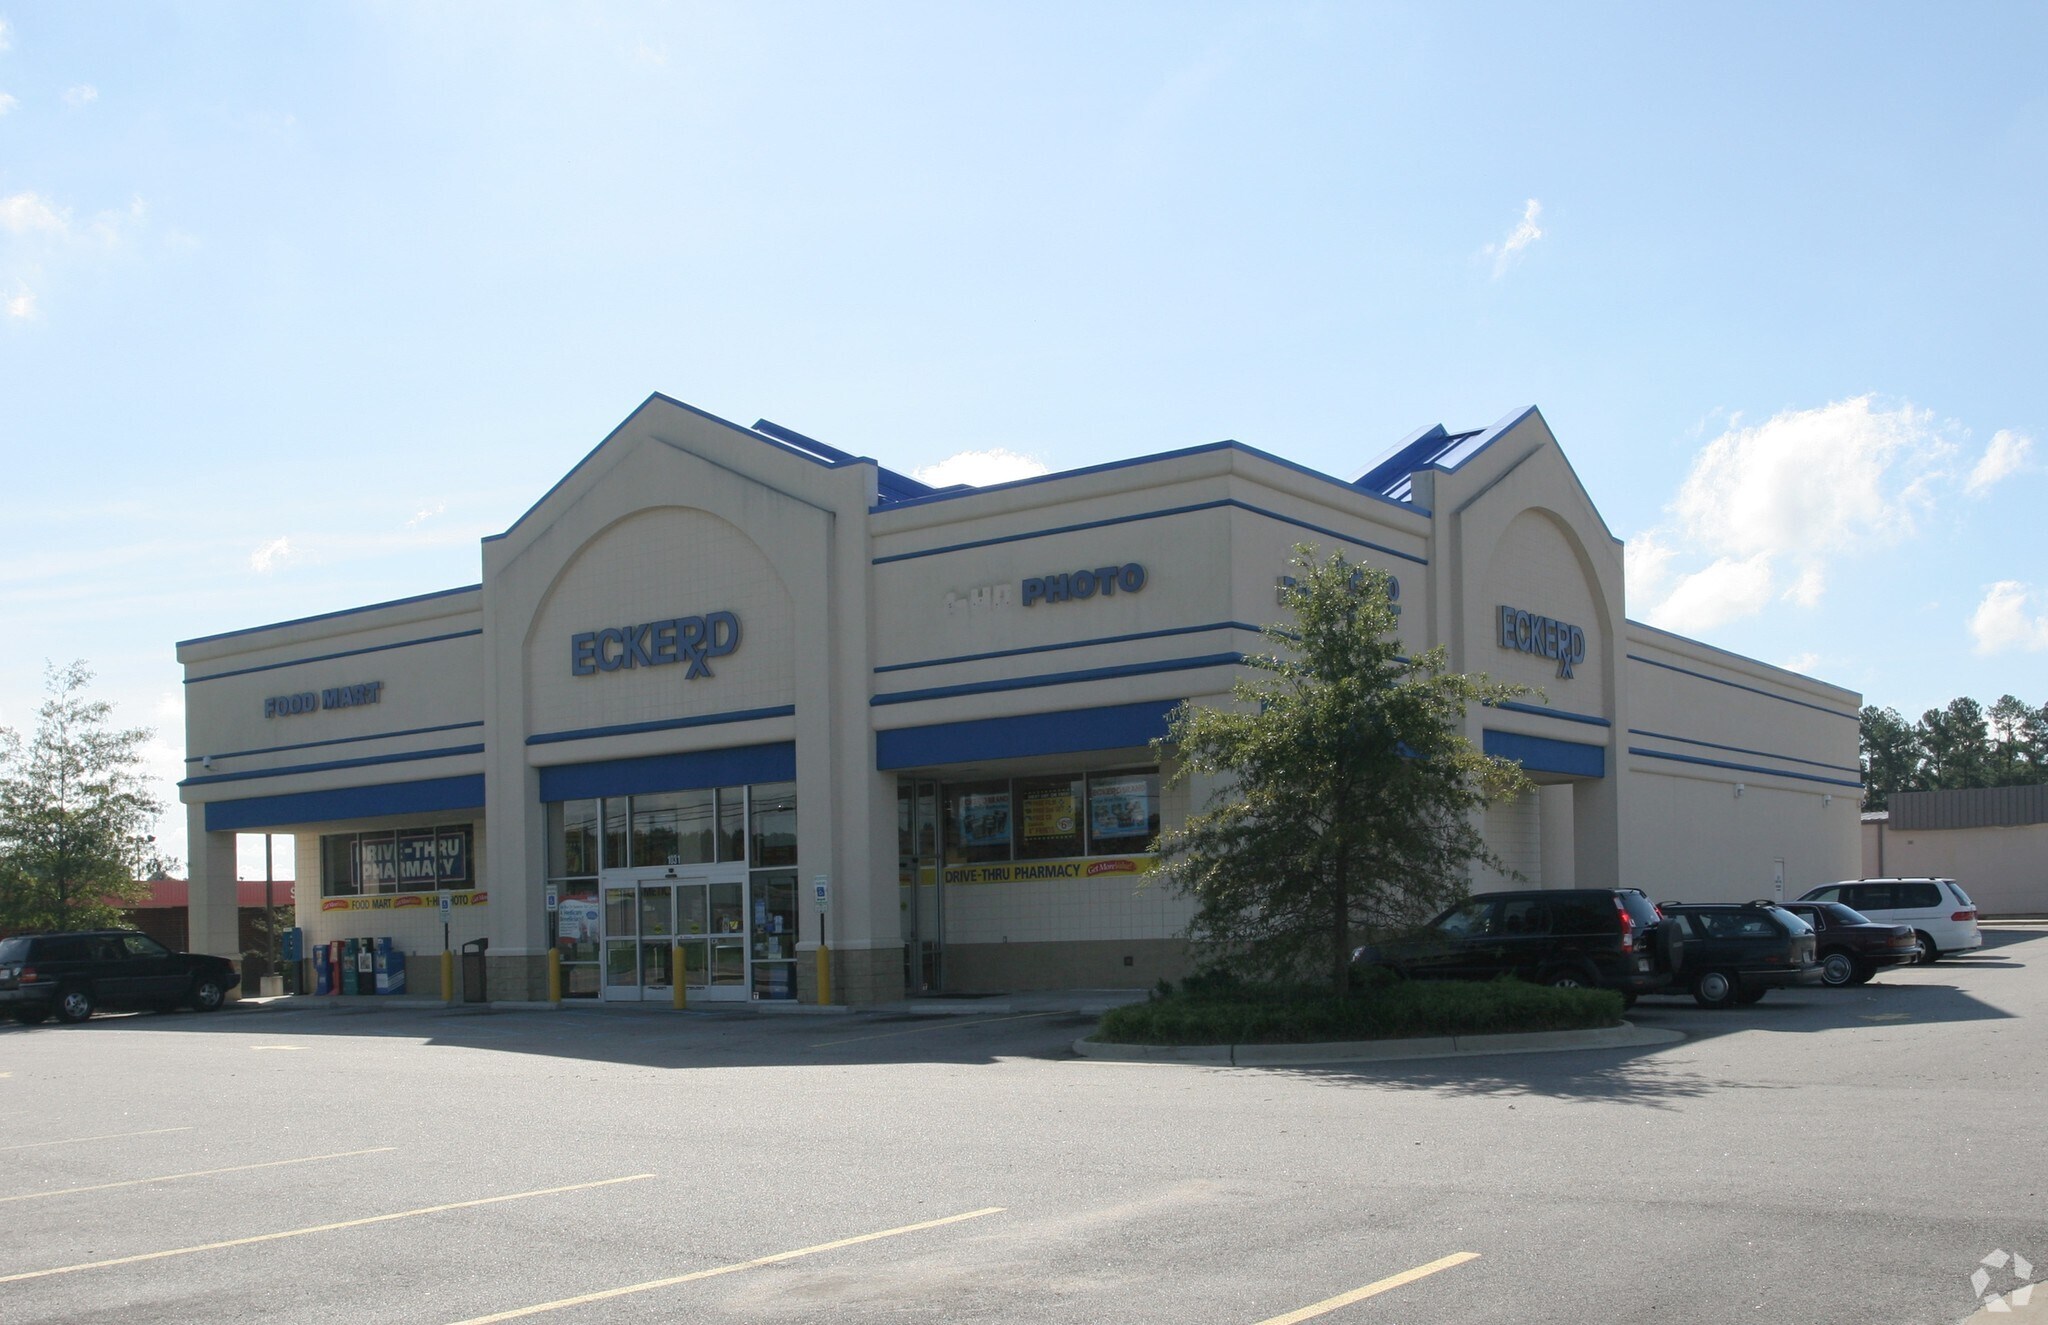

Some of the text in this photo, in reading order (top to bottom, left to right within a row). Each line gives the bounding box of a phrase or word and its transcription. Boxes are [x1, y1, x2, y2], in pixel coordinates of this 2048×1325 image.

[1022, 562, 1146, 607] PHOTO
[571, 611, 740, 680] ECKERD
[1500, 605, 1585, 679] ECKERD
[264, 681, 381, 719] FOOD MART
[945, 868, 1010, 883] DRIVE-THRU
[1014, 864, 1081, 880] PHARMACY
[352, 900, 369, 910] FOOD
[372, 898, 391, 909] MART
[450, 894, 469, 906] HOTO
